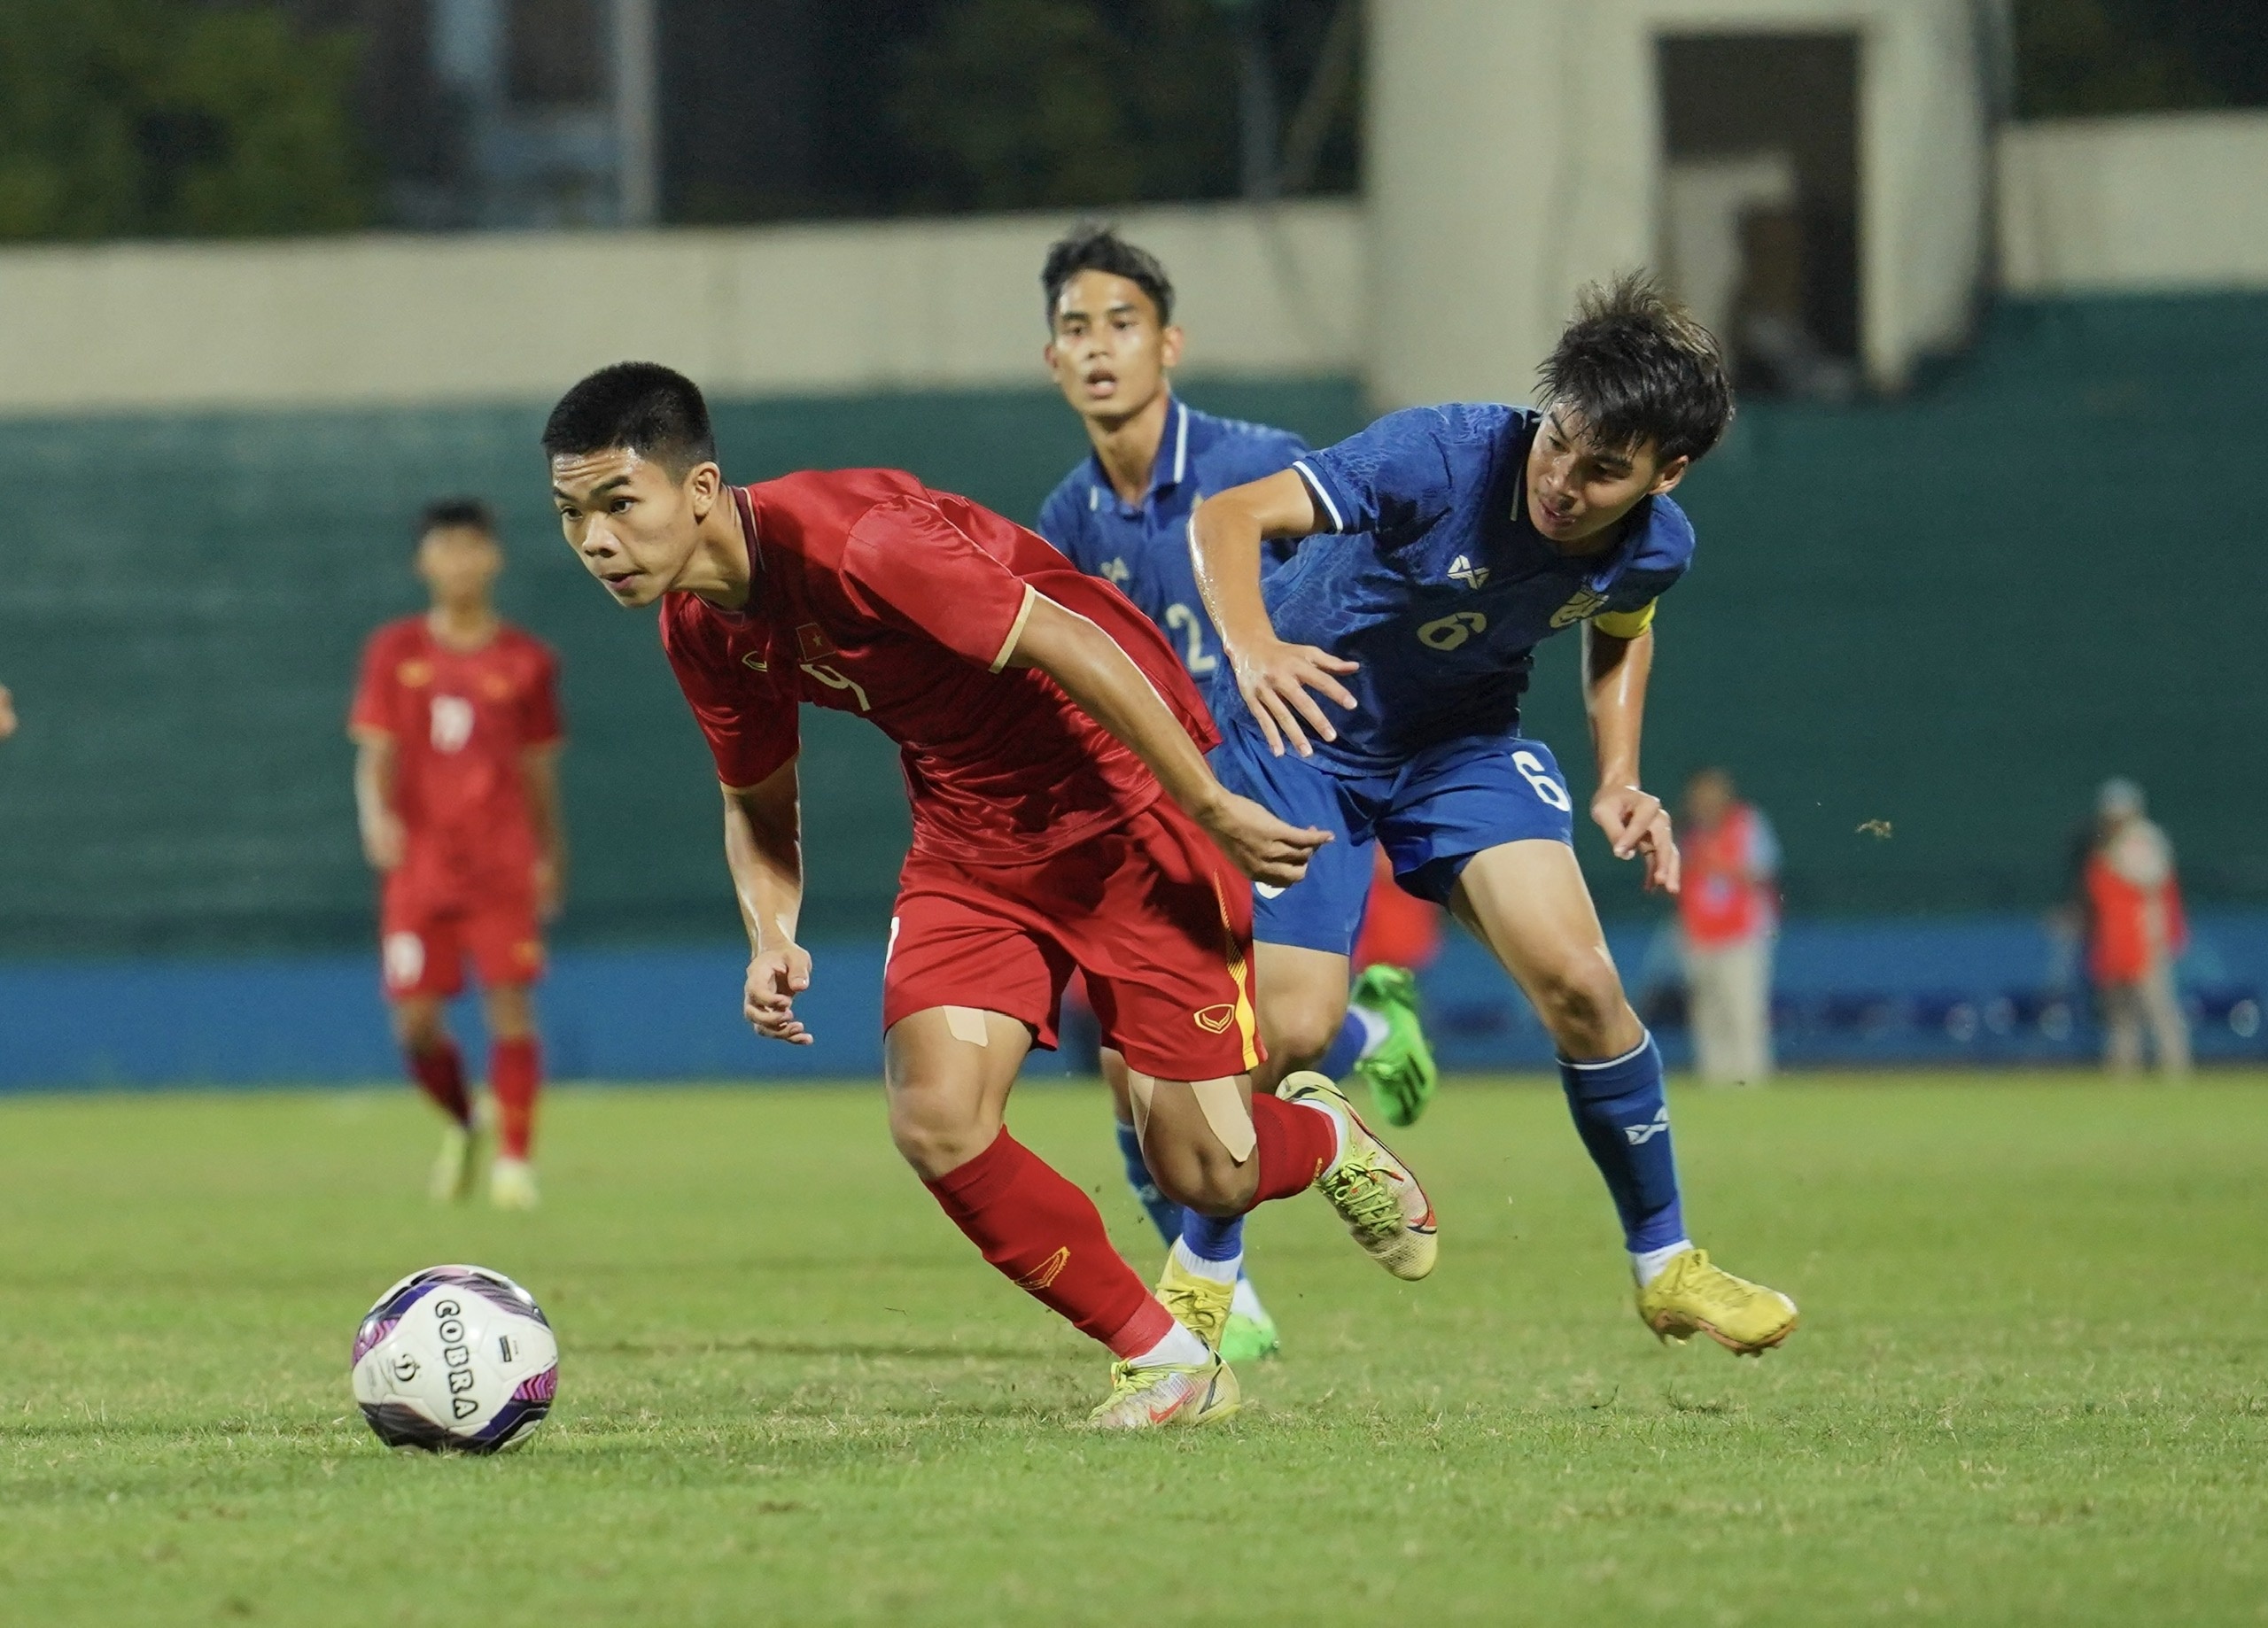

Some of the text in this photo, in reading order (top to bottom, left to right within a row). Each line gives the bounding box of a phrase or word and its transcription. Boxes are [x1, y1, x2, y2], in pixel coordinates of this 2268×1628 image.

[1417, 611, 1487, 651] 6
[799, 663, 871, 711] 9
[1511, 750, 1570, 812] 6
[434, 1299, 479, 1421] COBRA
